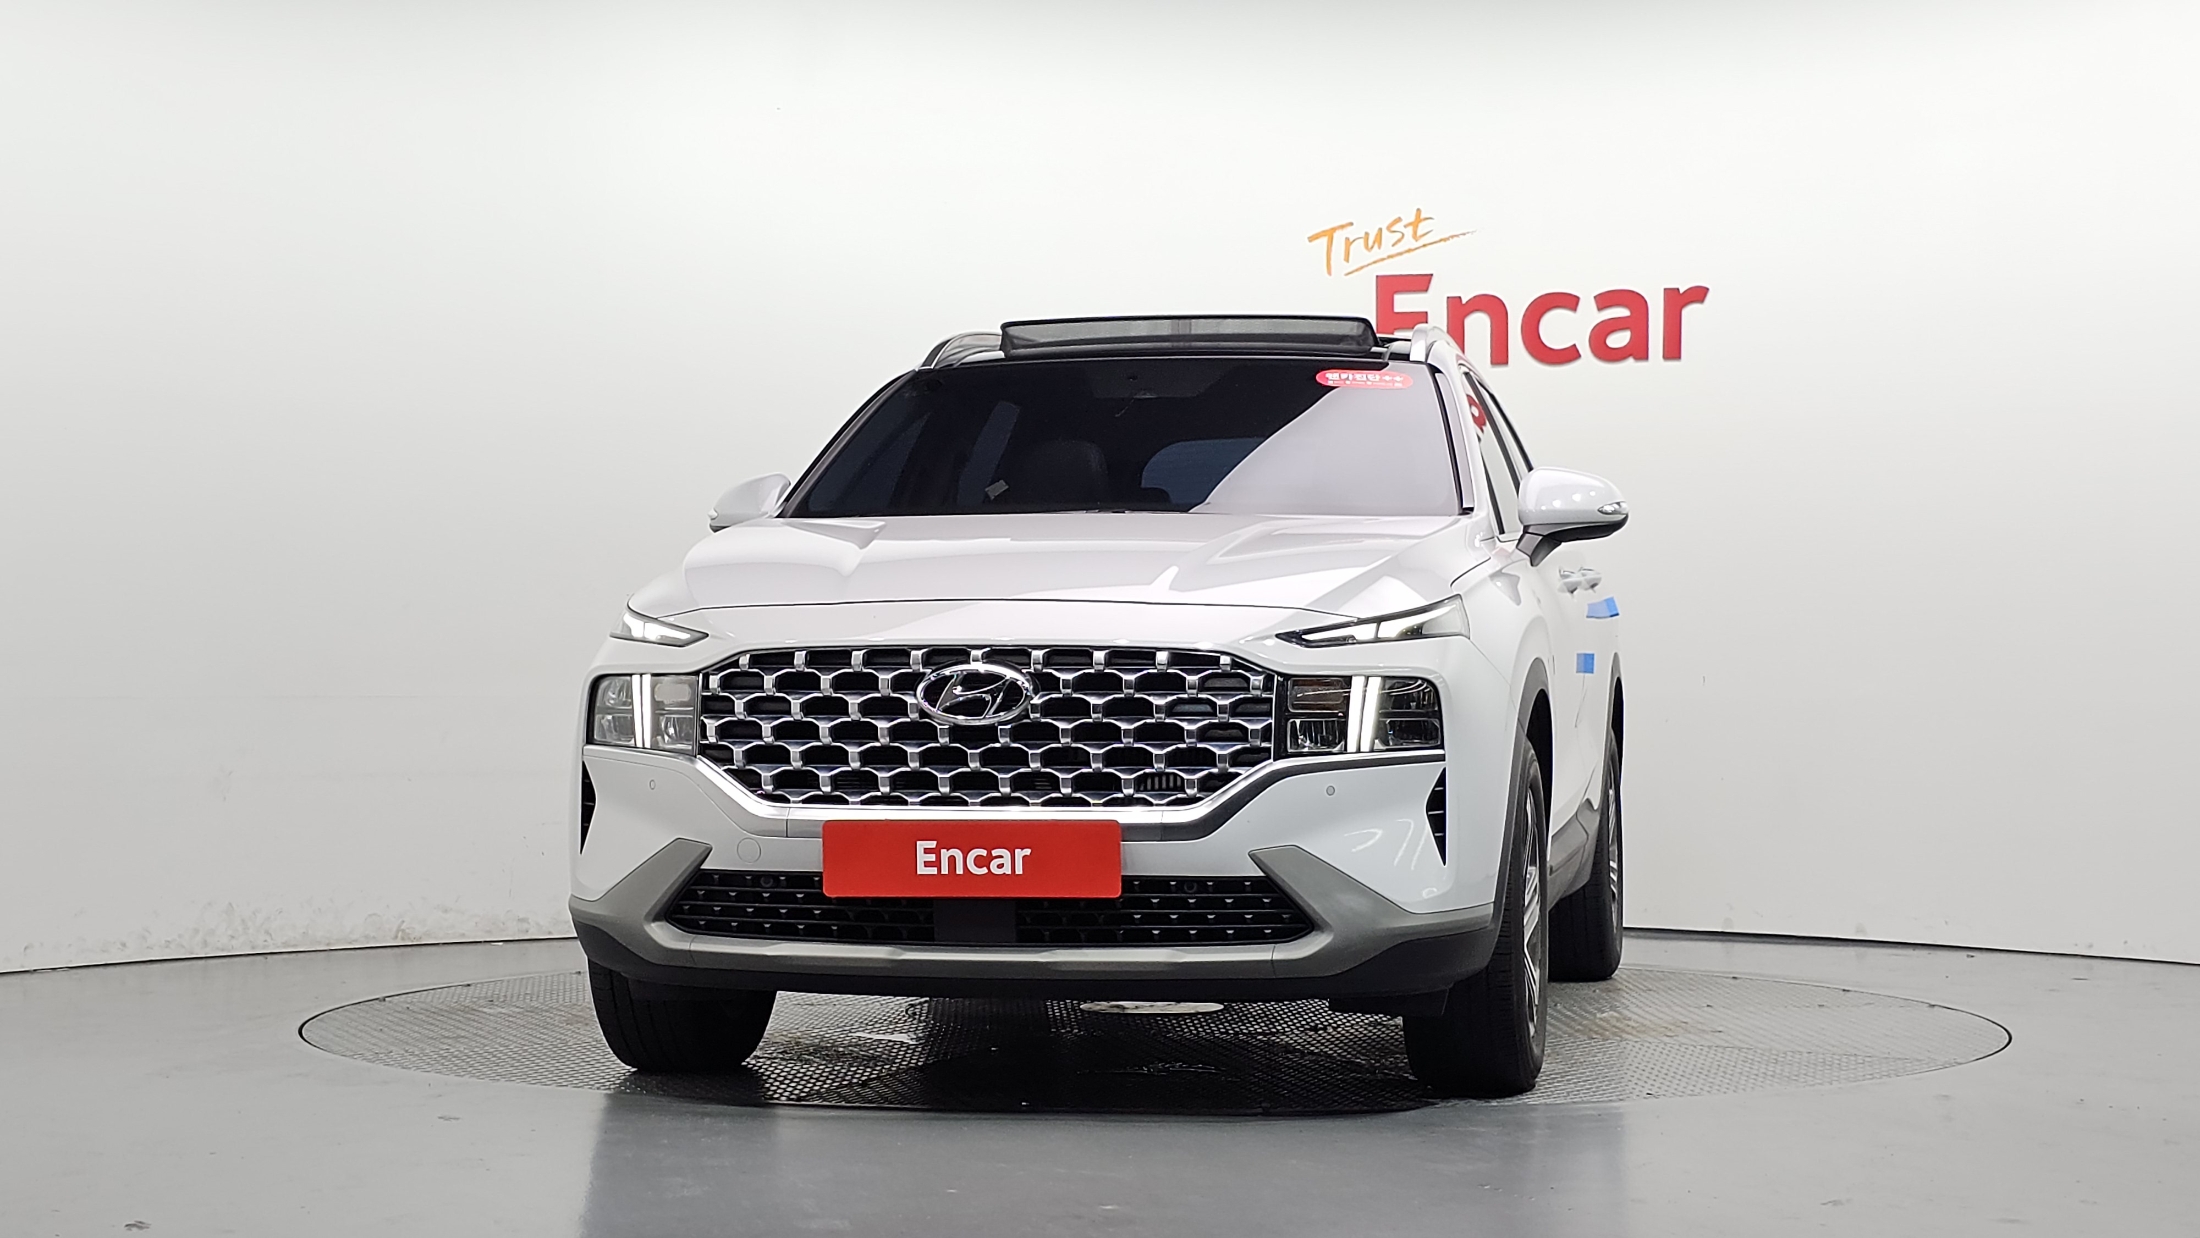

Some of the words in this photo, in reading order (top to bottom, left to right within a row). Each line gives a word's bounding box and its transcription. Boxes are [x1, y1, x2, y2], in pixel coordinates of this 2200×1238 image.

[1308, 208, 1434, 276] Trust
[1375, 273, 1710, 367] Encar
[915, 840, 1031, 875] Encar
